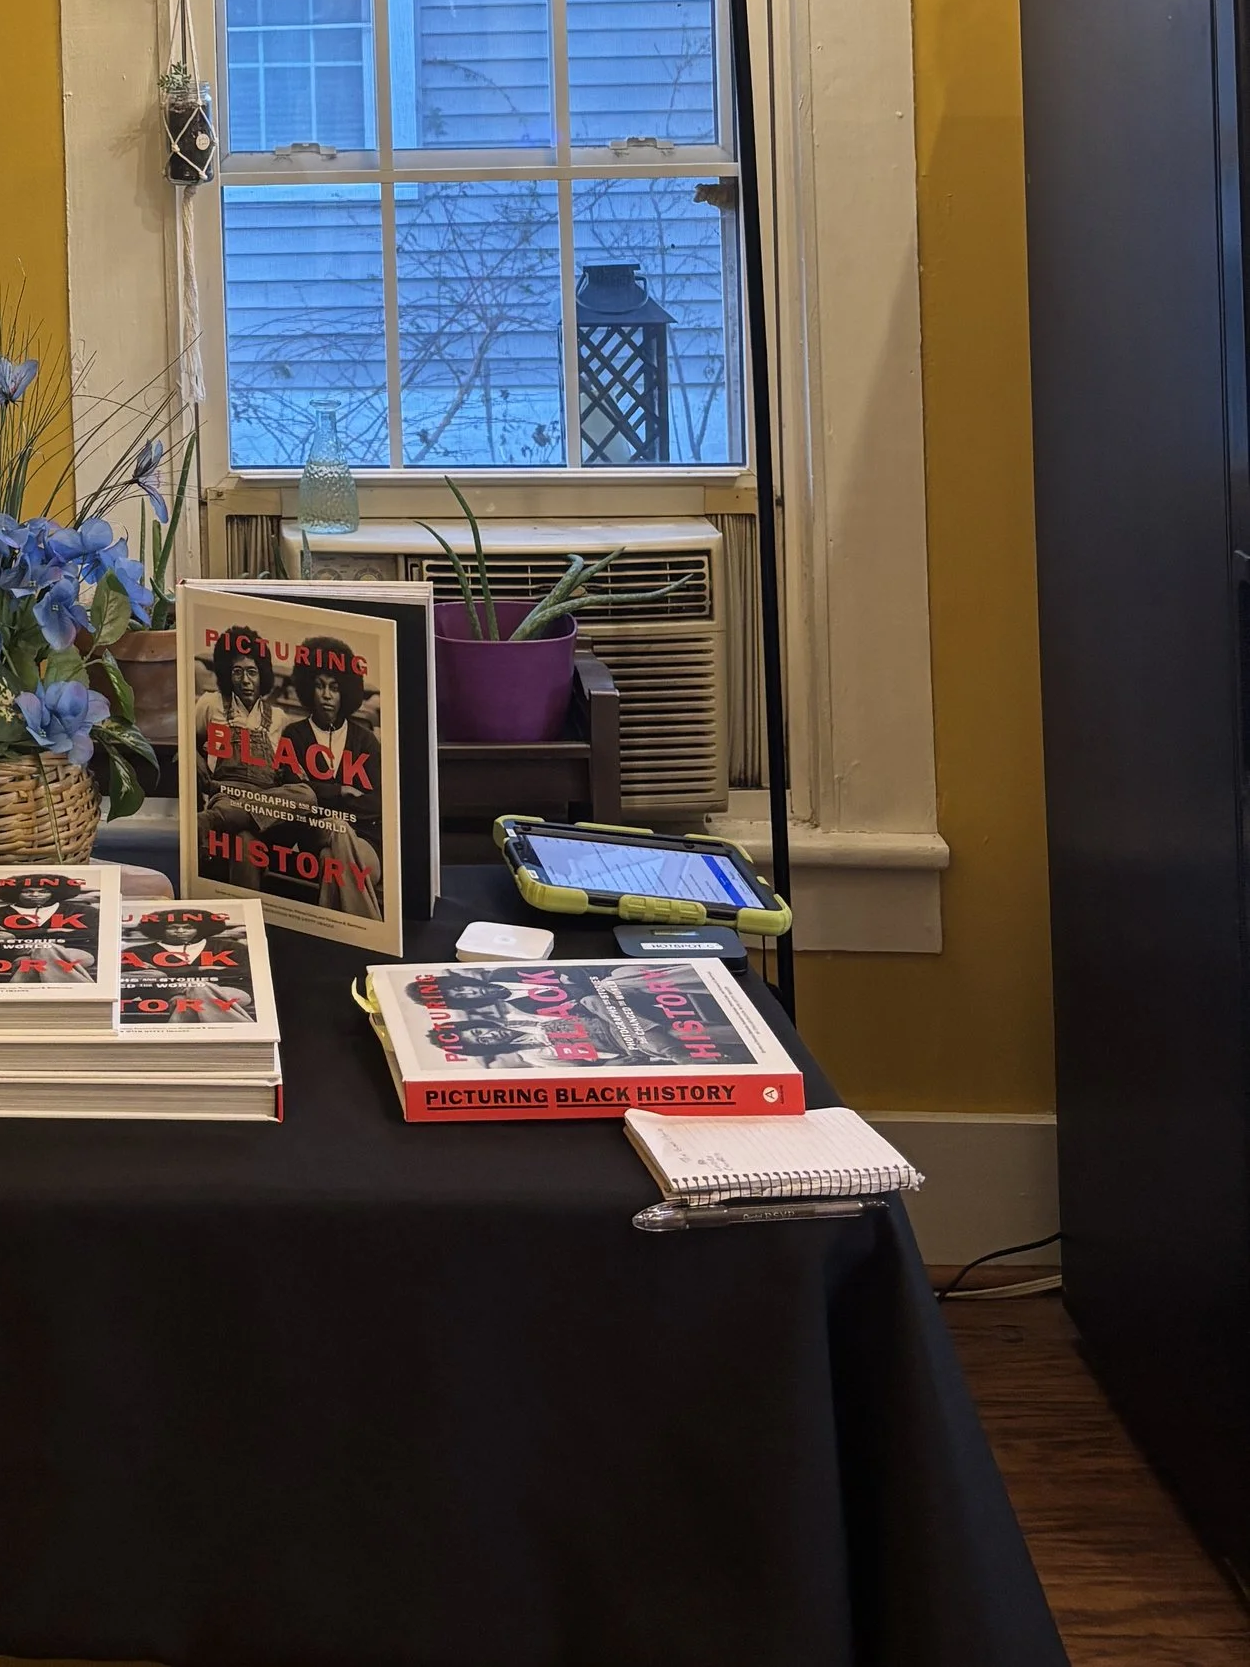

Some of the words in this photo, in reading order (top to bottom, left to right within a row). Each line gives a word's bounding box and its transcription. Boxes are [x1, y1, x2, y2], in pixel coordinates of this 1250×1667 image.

[205, 629, 368, 676] PICTURING
[207, 723, 373, 790] BLACK
[220, 785, 296, 809] PHOTOGRAPHS
[311, 805, 357, 823] STORIES
[244, 803, 294, 822] CHANGED
[309, 818, 347, 833] WORLD
[208, 830, 372, 893] HISTORY
[121, 913, 230, 922] URING
[121, 950, 239, 968] ACK
[121, 998, 240, 1013] TORY
[415, 974, 468, 1063] PICTURING
[517, 969, 599, 1062] BLACK
[622, 1007, 645, 1036] CHANGED
[640, 969, 721, 1060] HISTORY
[606, 1006, 639, 1050] PHOTOGRAPHS
[426, 1088, 548, 1105] PICTURING
[555, 1087, 631, 1103] BLACK
[637, 1085, 736, 1101] HISTORY
[765, 1089, 775, 1100] A
